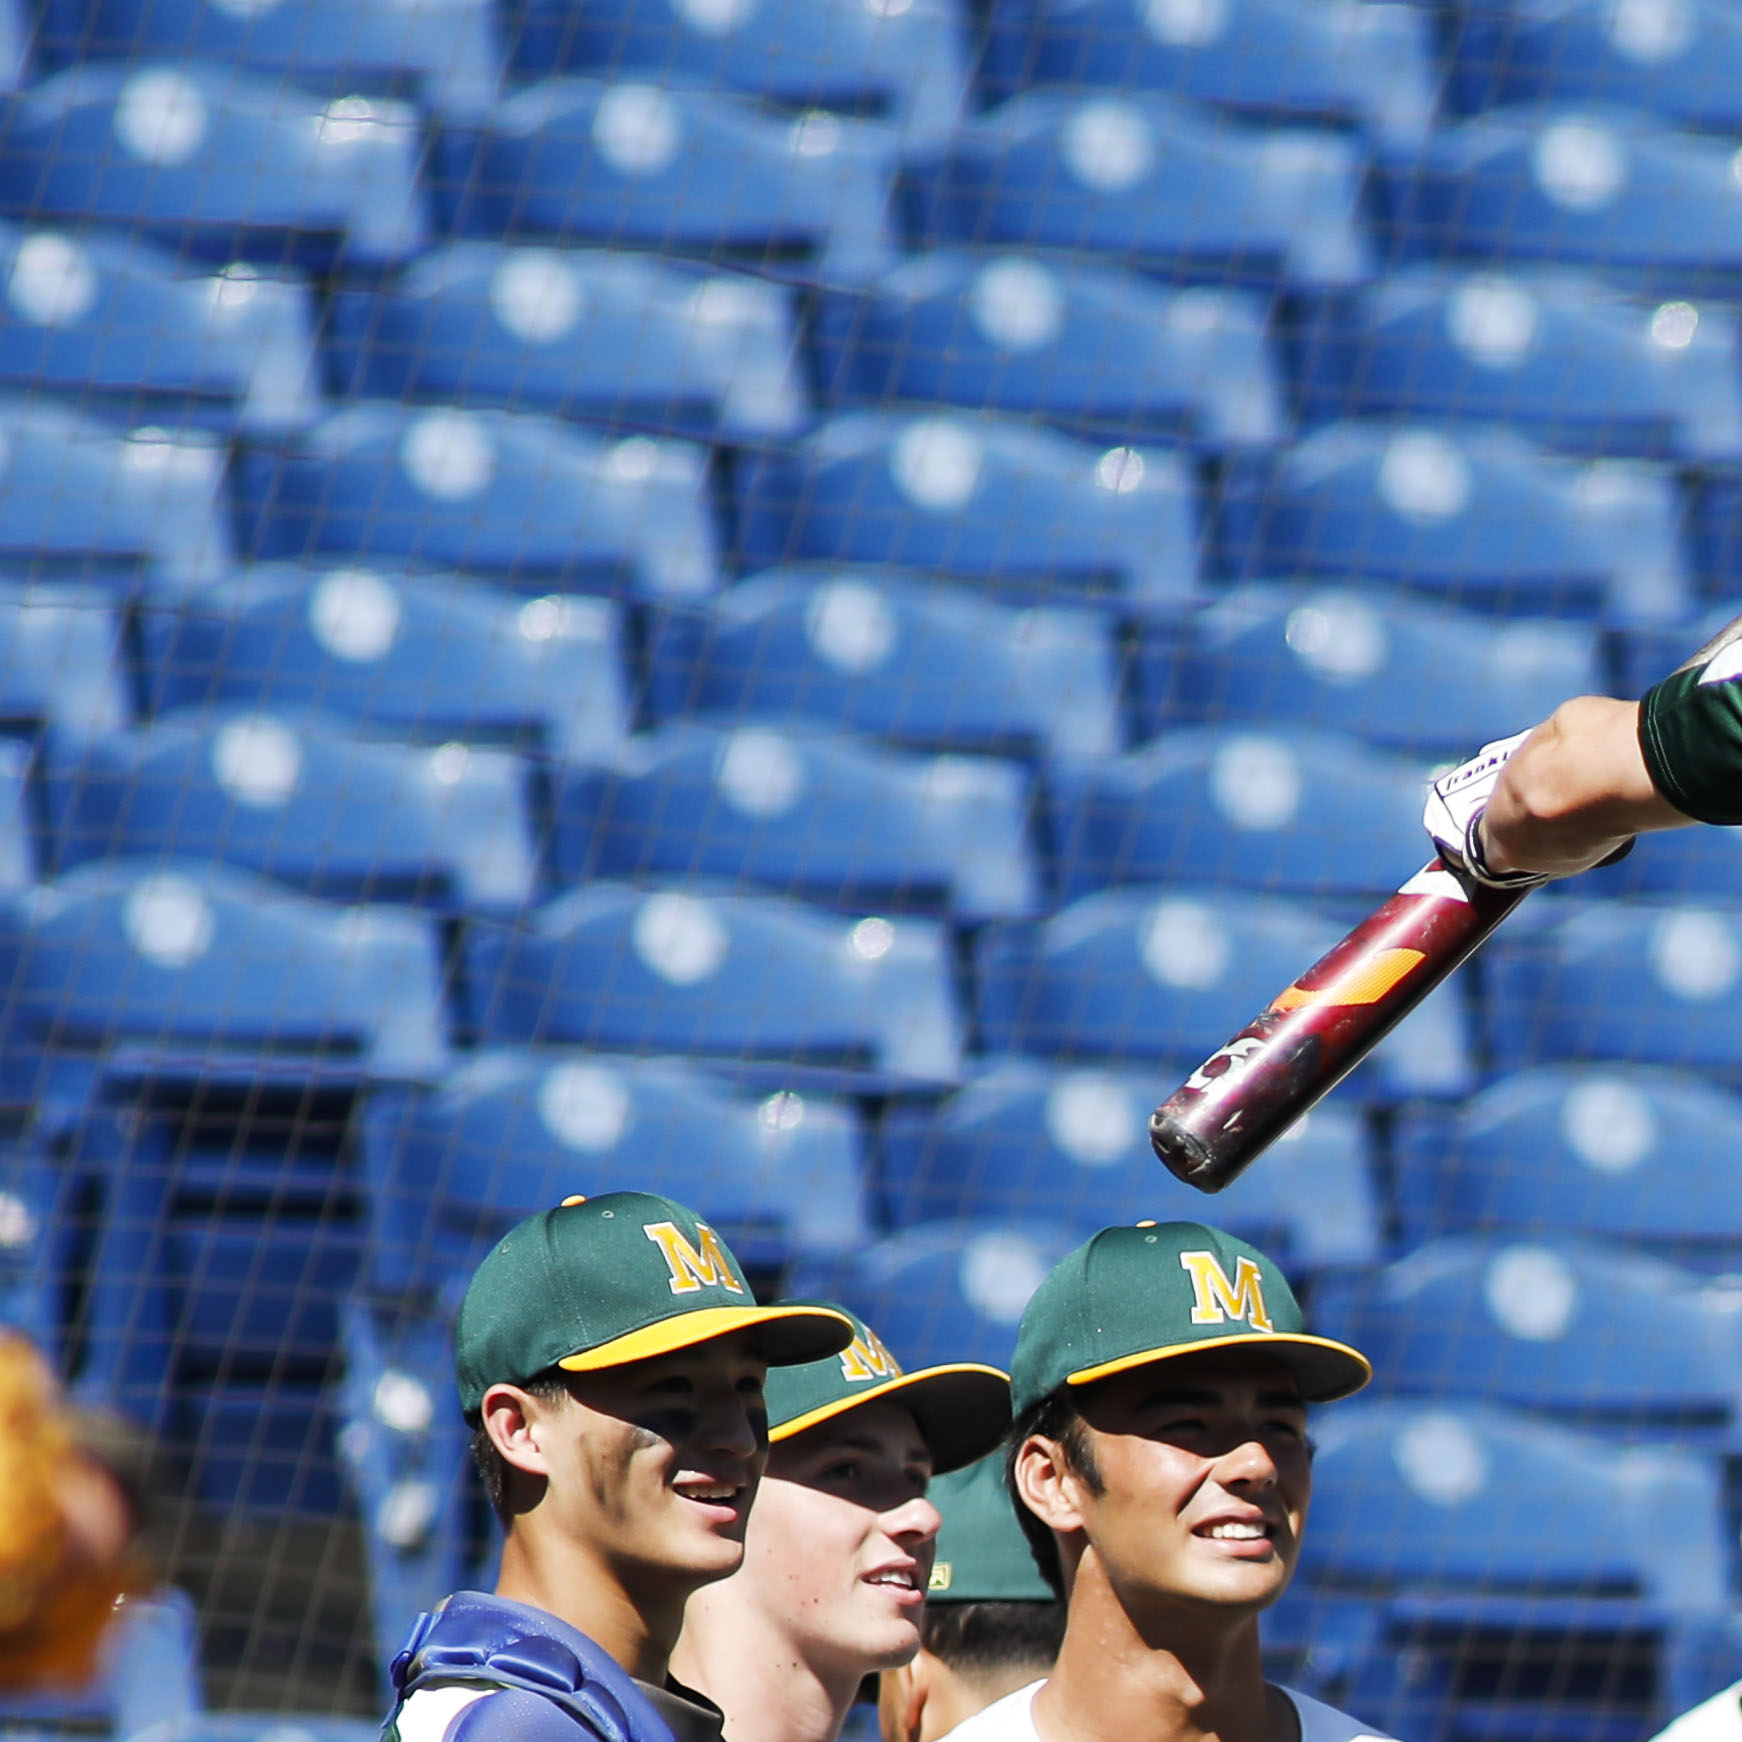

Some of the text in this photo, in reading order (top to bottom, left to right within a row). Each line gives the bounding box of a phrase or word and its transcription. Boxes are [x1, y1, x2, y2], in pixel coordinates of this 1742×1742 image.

[643, 1221, 745, 1296] M
[1180, 1251, 1274, 1333] M
[839, 1322, 904, 1382] M
